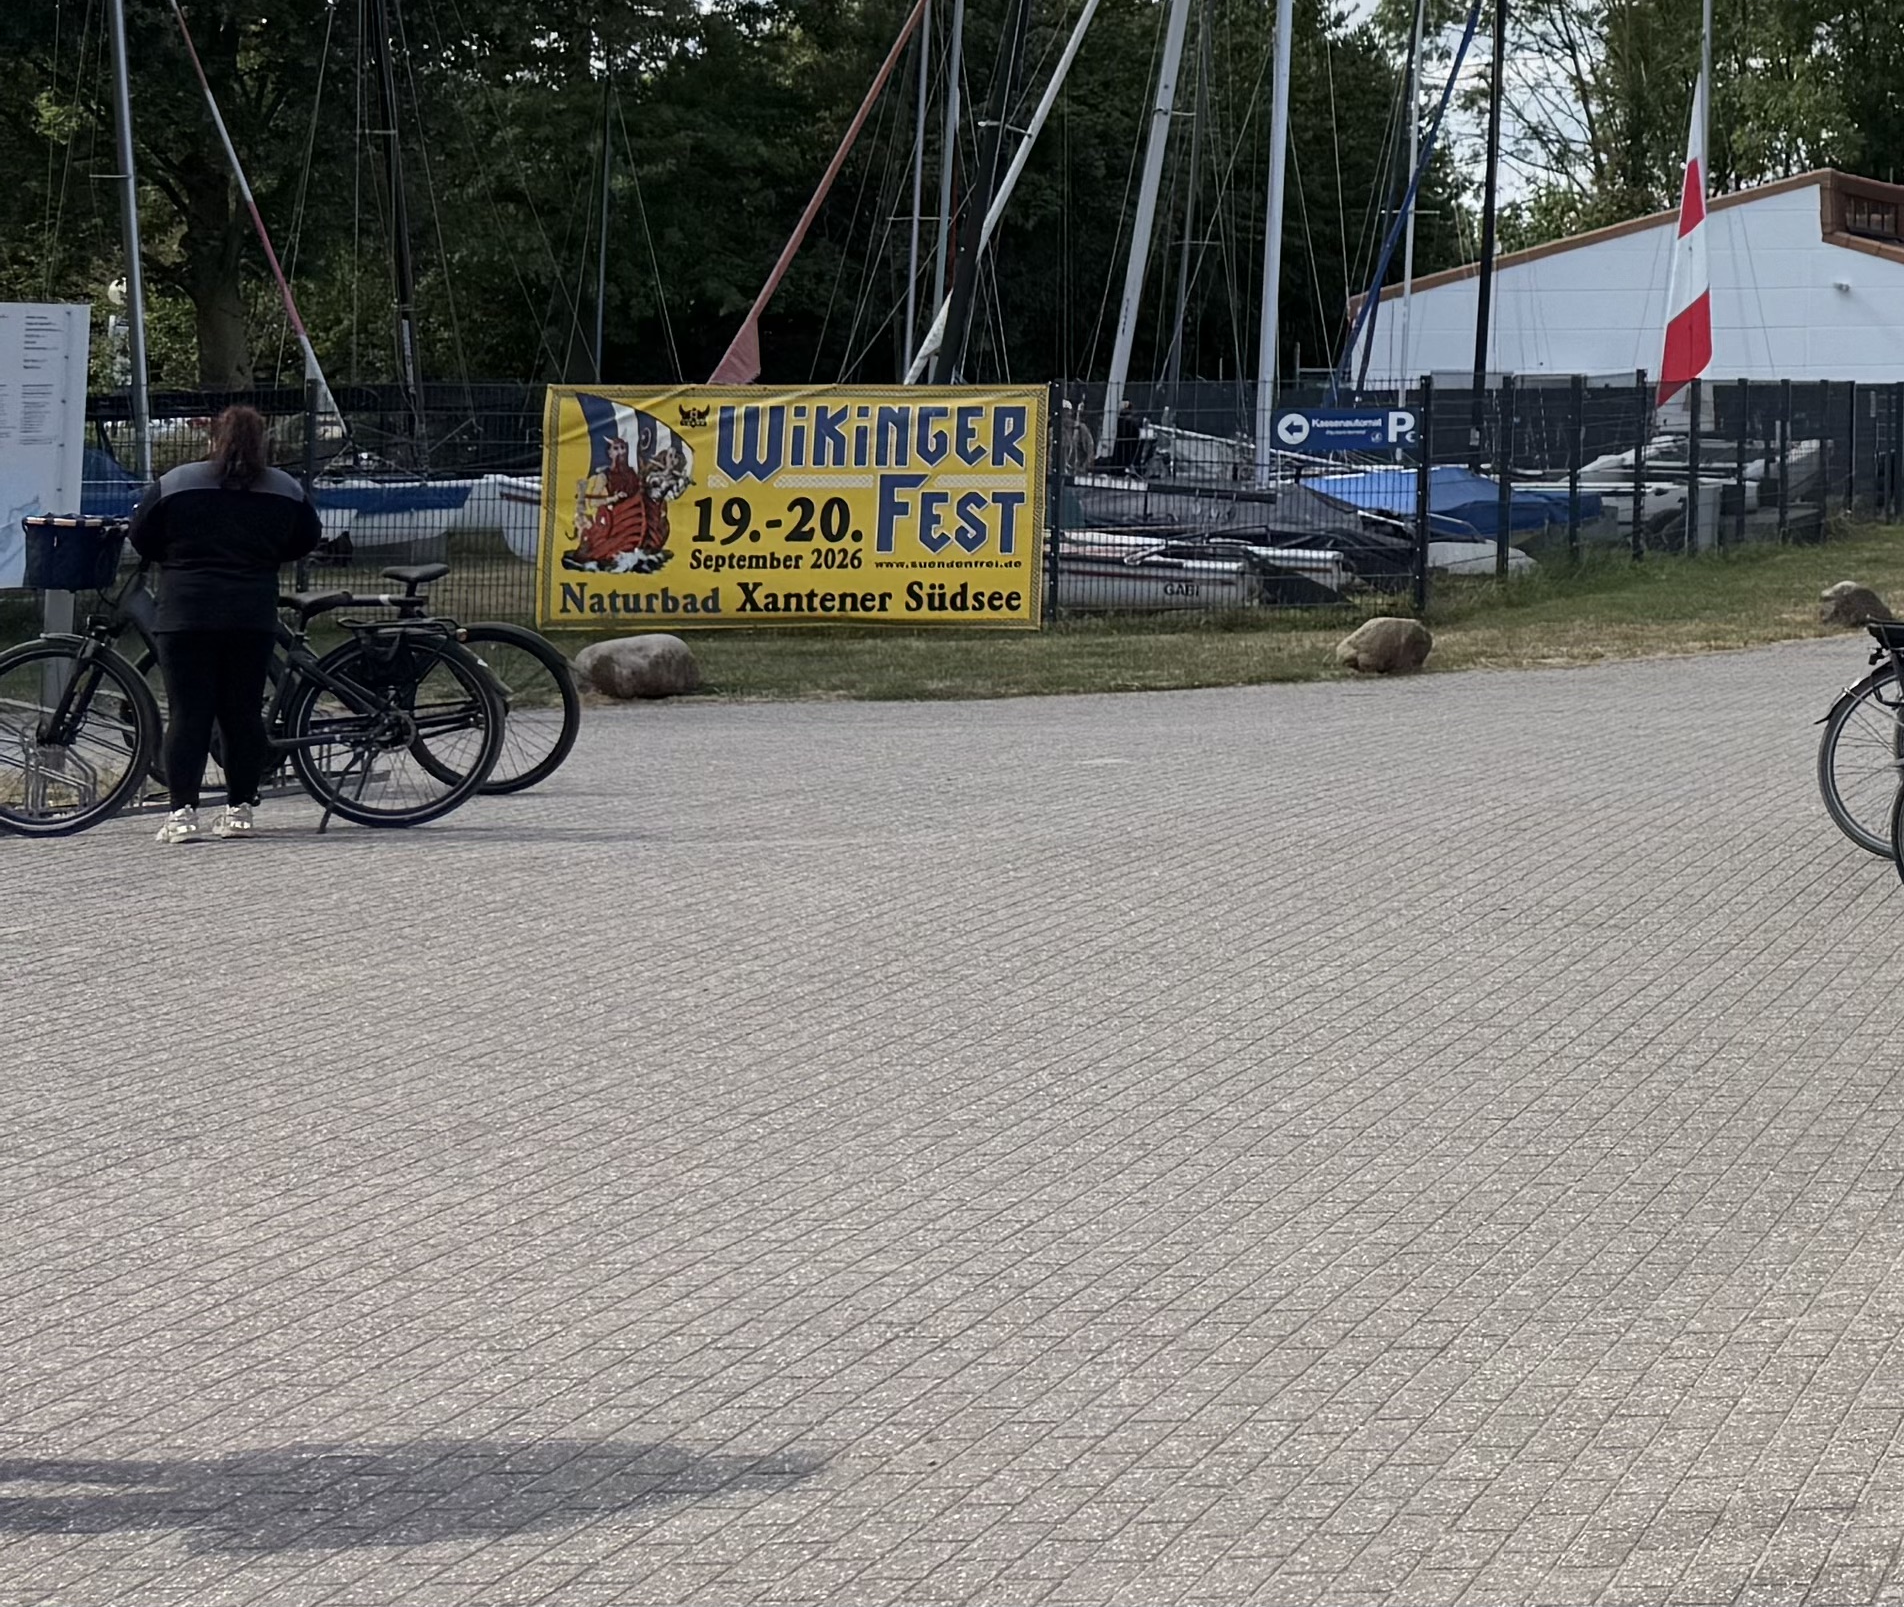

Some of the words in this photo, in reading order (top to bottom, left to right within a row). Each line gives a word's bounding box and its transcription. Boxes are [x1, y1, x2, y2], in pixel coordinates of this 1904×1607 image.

[1311, 418, 1382, 428] Kassenautomat
[1388, 411, 1415, 443] P
[692, 496, 863, 545] 19.-20.
[690, 548, 803, 572] September
[810, 548, 863, 570] 2026
[559, 582, 722, 615] Naturbad
[736, 582, 892, 613] Xantener
[905, 580, 1022, 612] Südsee
